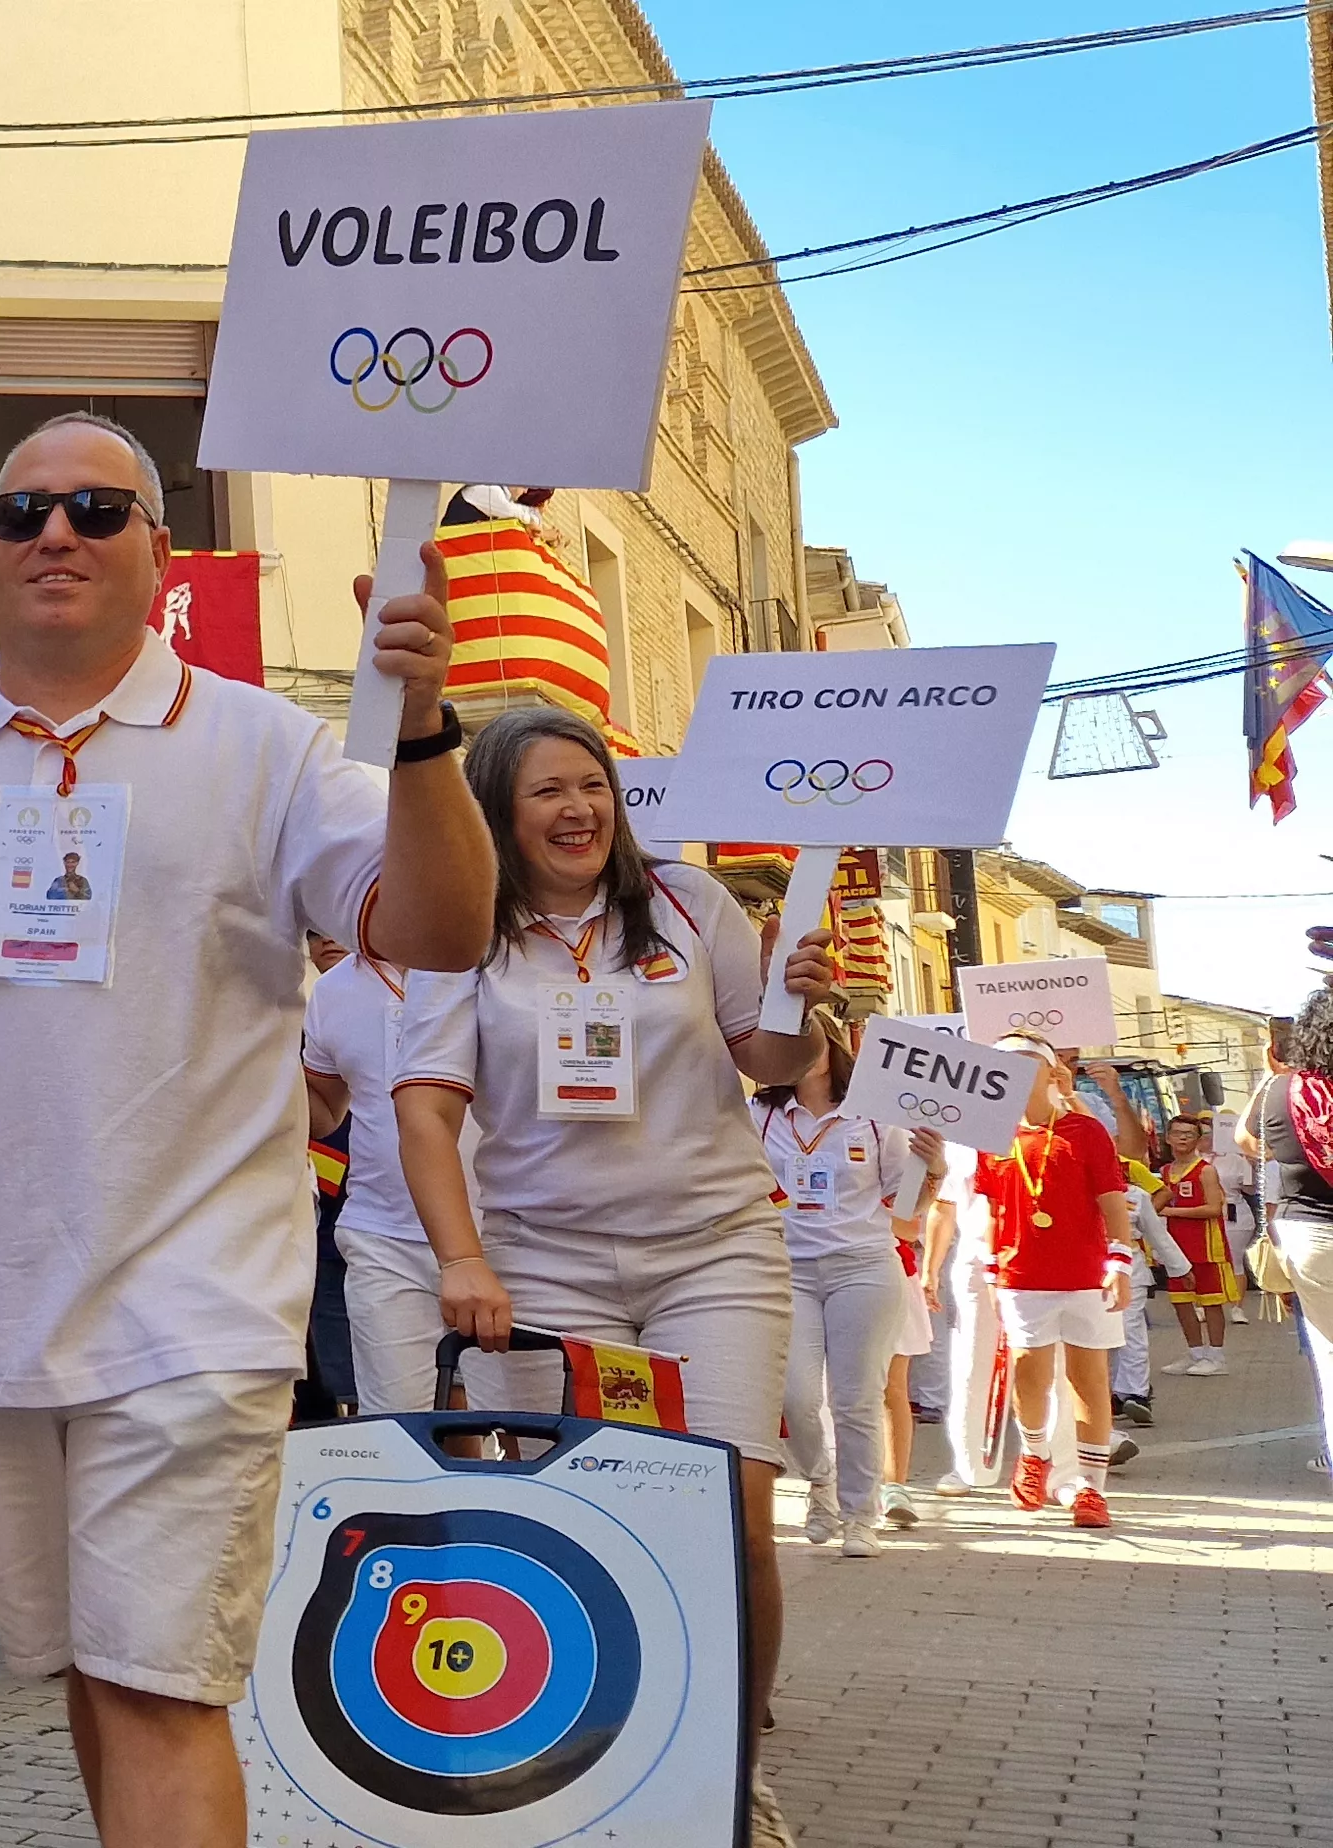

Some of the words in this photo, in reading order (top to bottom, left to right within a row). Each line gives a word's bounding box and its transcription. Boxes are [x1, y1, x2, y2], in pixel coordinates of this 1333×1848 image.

[278, 197, 620, 267] VOLEIBOL
[730, 690, 804, 711] TIRO
[813, 688, 889, 710] CON
[896, 685, 998, 708] ARCO
[9, 903, 46, 912] FLORIAN
[48, 904, 81, 913] TRITTEL
[27, 927, 57, 936] SPAIN
[975, 975, 1089, 995] TAEKWONDO
[878, 1037, 1010, 1101] TENIS
[319, 1448, 381, 1460] GEOLOGIC
[568, 1456, 717, 1479] SOFTARCHERY
[312, 1496, 332, 1520] 6
[342, 1528, 366, 1557] 7
[369, 1559, 394, 1589] 8
[401, 1593, 428, 1625] 9
